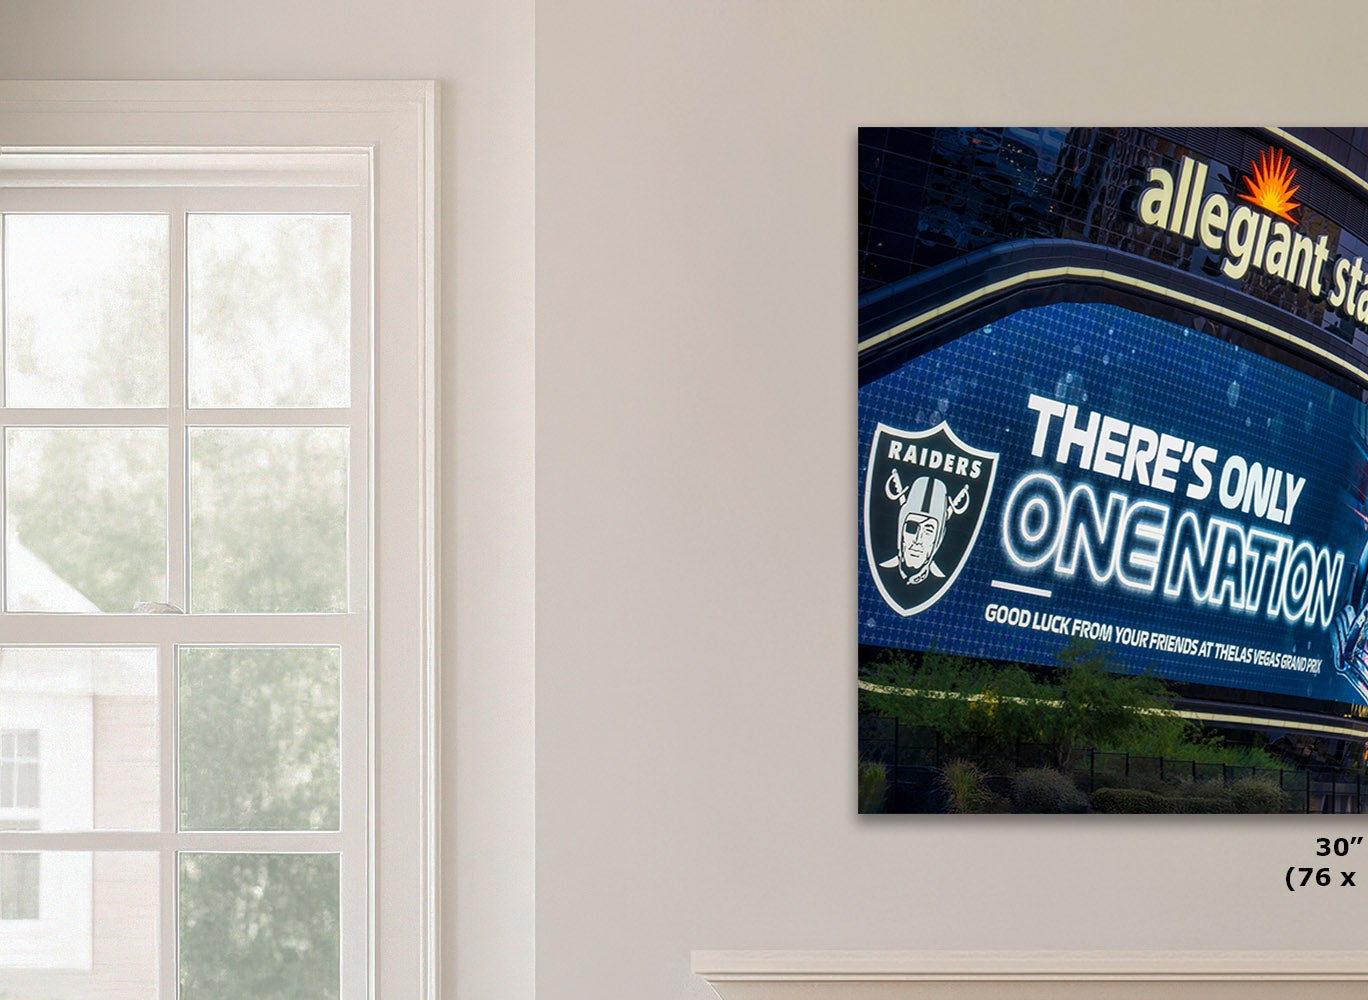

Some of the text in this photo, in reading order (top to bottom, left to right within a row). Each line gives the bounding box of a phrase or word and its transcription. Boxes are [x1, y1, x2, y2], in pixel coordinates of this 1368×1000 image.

[1139, 155, 1329, 296] allegiant
[888, 440, 982, 478] RAIDERS
[1027, 393, 1306, 525] THERE'S ONLY
[1003, 472, 1345, 627] ONE NATION
[984, 603, 1031, 628] GOOD
[1031, 612, 1072, 635] LUCK
[1071, 619, 1113, 642] FROM
[1115, 626, 1150, 648] YOUR
[1149, 632, 1199, 656] FRIENDS
[1198, 641, 1215, 658] AT
[1253, 649, 1281, 668] VEGAS
[1280, 654, 1307, 672] GRAND
[1306, 658, 1323, 674] PRIX
